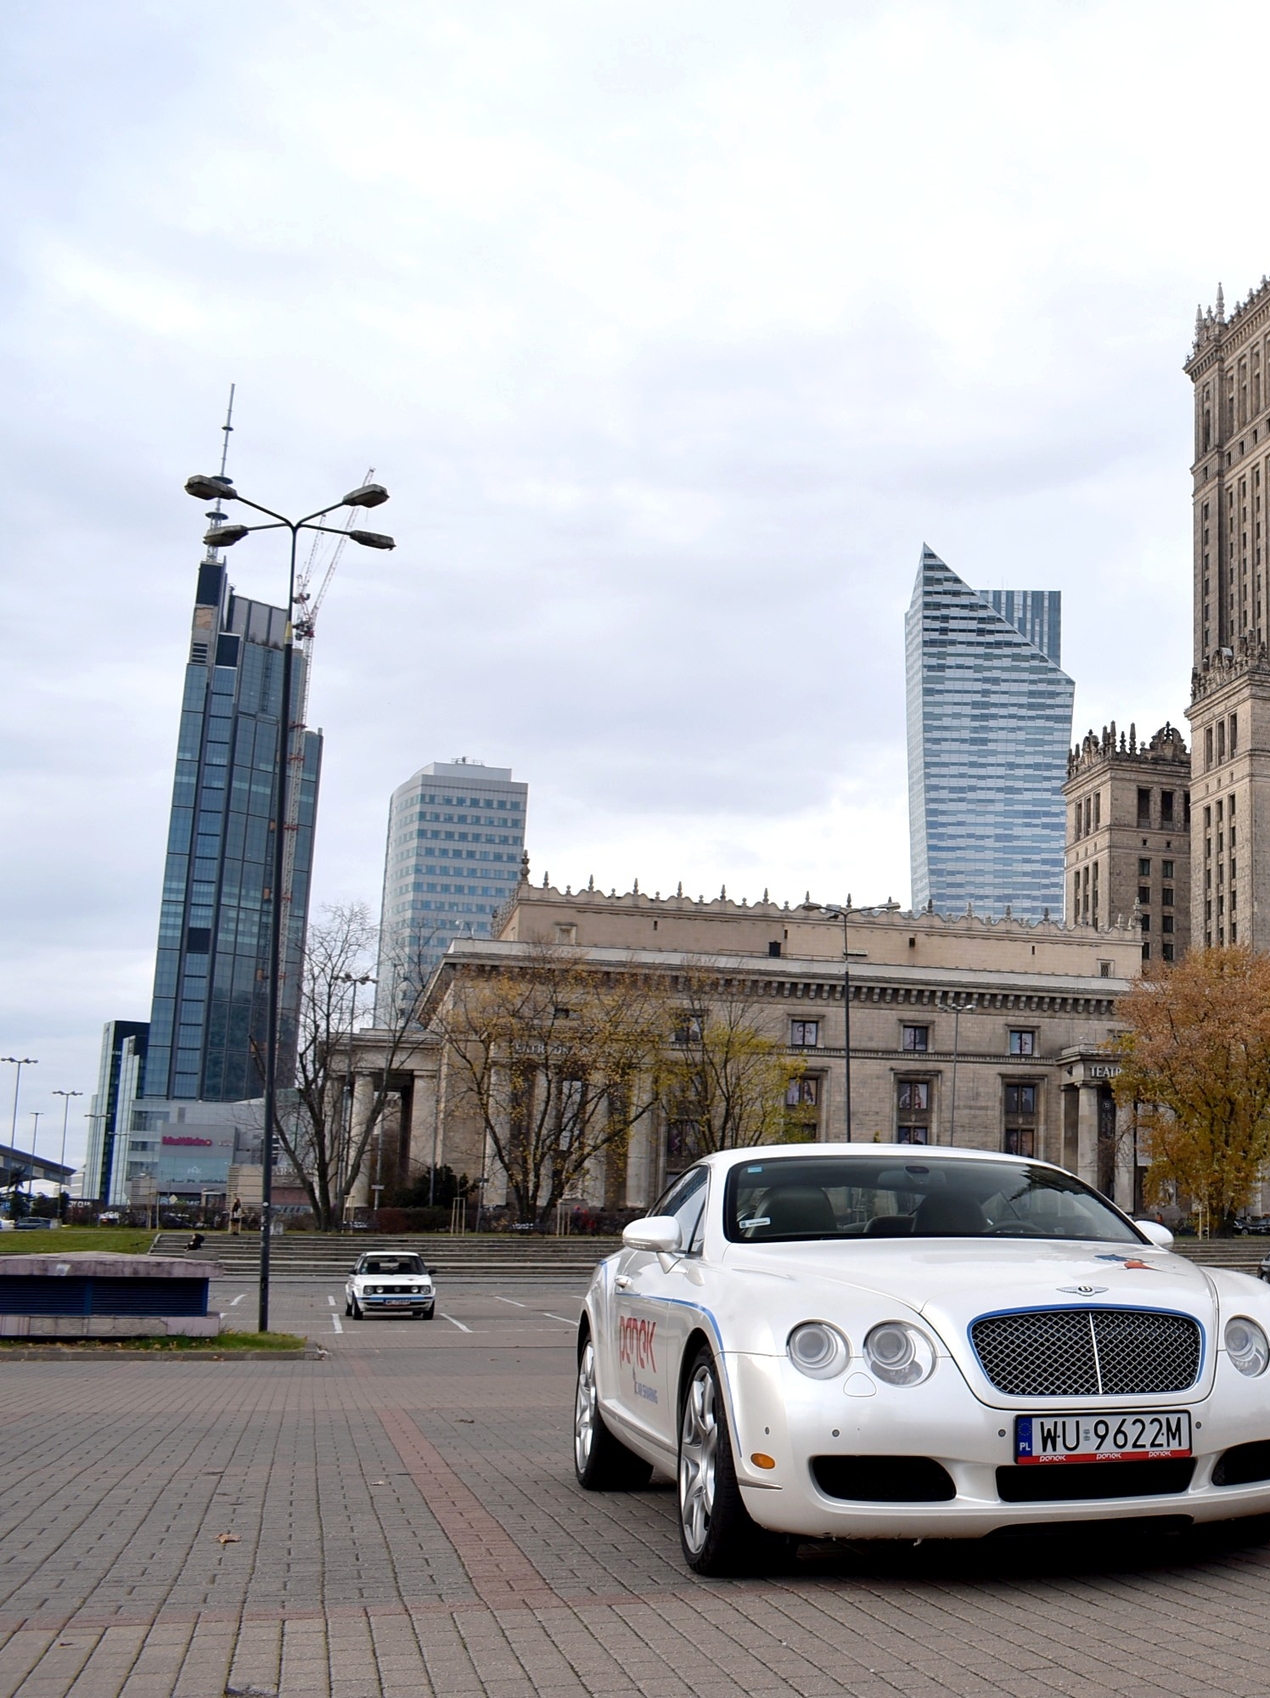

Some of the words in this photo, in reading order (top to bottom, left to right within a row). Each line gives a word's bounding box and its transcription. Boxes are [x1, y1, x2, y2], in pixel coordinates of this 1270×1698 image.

[1040, 1420, 1080, 1452] WU
[1093, 1416, 1182, 1450] 9622M
[1019, 1442, 1031, 1451] PL
